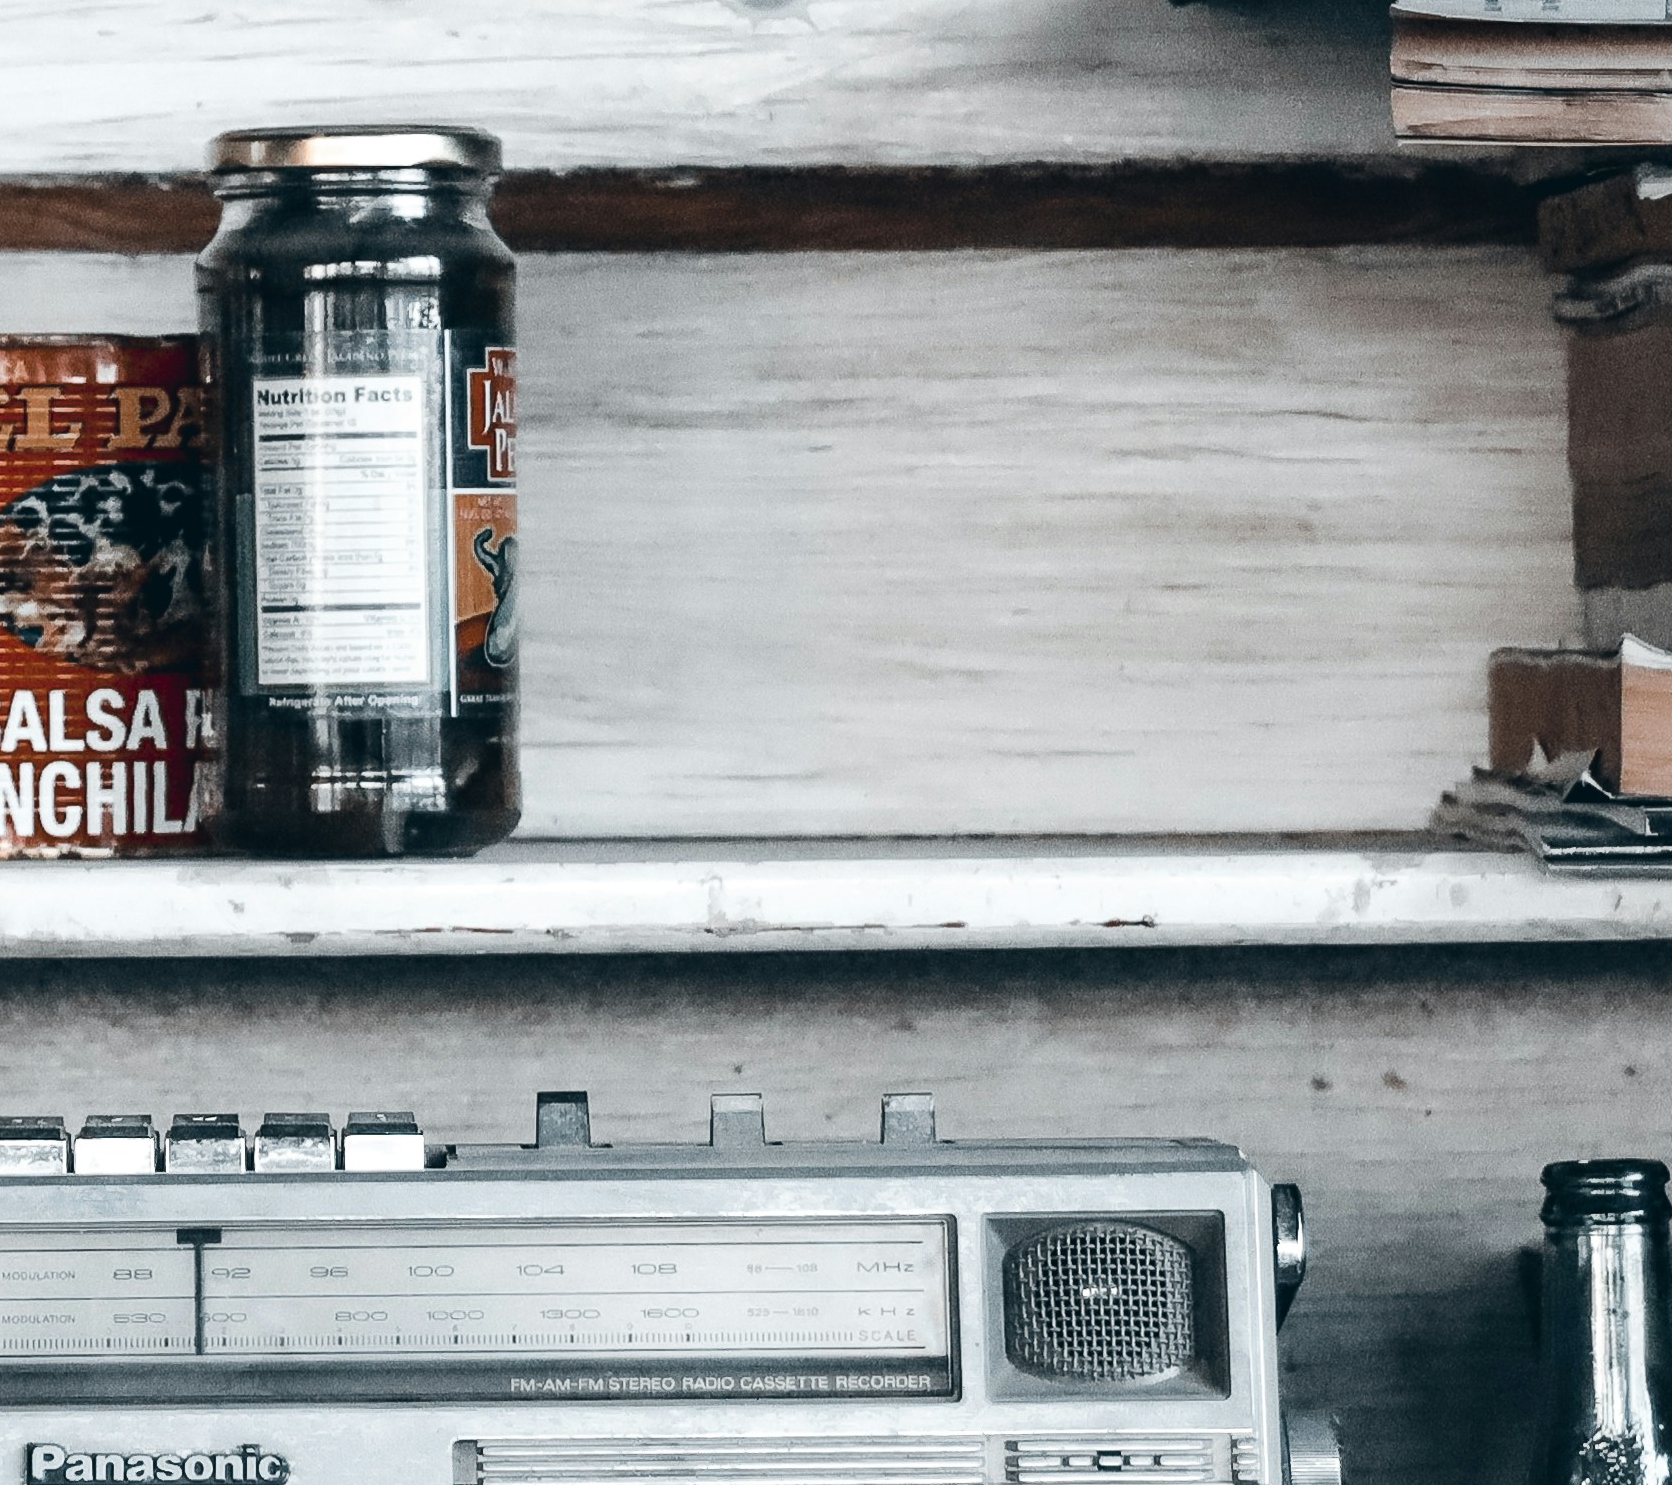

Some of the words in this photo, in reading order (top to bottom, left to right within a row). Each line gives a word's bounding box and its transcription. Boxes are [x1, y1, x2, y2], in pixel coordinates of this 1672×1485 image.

[256, 387, 347, 407] Nutrition
[354, 384, 414, 405] Facts
[269, 695, 329, 709] Refrigerate
[333, 694, 366, 708] After
[368, 693, 421, 710] Opening
[0, 1269, 78, 1283] MODULATION
[111, 1267, 155, 1282] 88
[209, 1265, 253, 1281] 92
[308, 1264, 351, 1280] 96
[406, 1263, 456, 1279] 100
[515, 1262, 567, 1278] 104
[630, 1261, 679, 1277] 108
[855, 1260, 915, 1274] MHz
[509, 1377, 606, 1393] FM-AM-FM
[607, 1376, 678, 1393] STEREO
[680, 1375, 737, 1392] RADIO
[738, 1375, 831, 1392] CASSETTE
[834, 1374, 933, 1391] RECORDER
[31, 1443, 286, 1484] Panasonic
